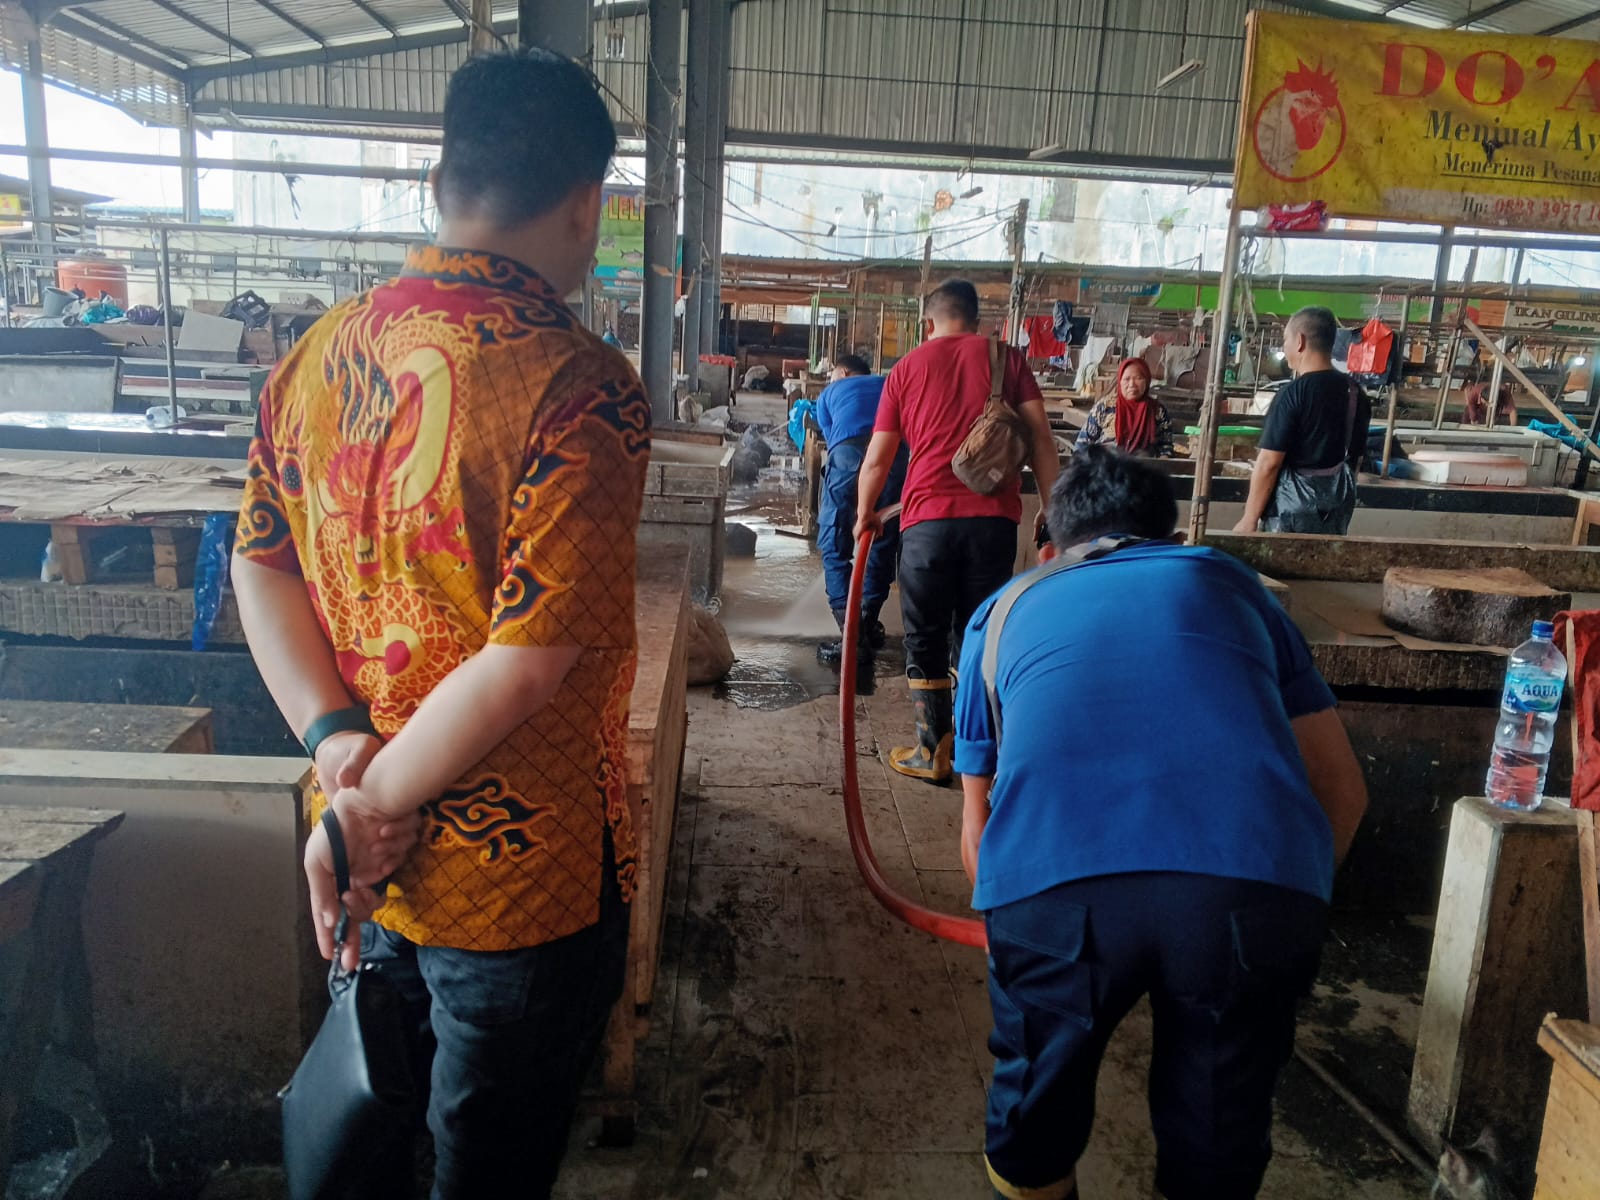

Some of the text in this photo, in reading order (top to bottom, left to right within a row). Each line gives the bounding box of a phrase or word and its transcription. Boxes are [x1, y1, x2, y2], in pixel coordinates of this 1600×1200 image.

[1424, 109, 1551, 154] Menjual
[1443, 152, 1535, 177] Menerima
[1099, 283, 1144, 293] LESTARI
[1514, 306, 1552, 319] IKAN
[1522, 684, 1558, 698] AQUA
